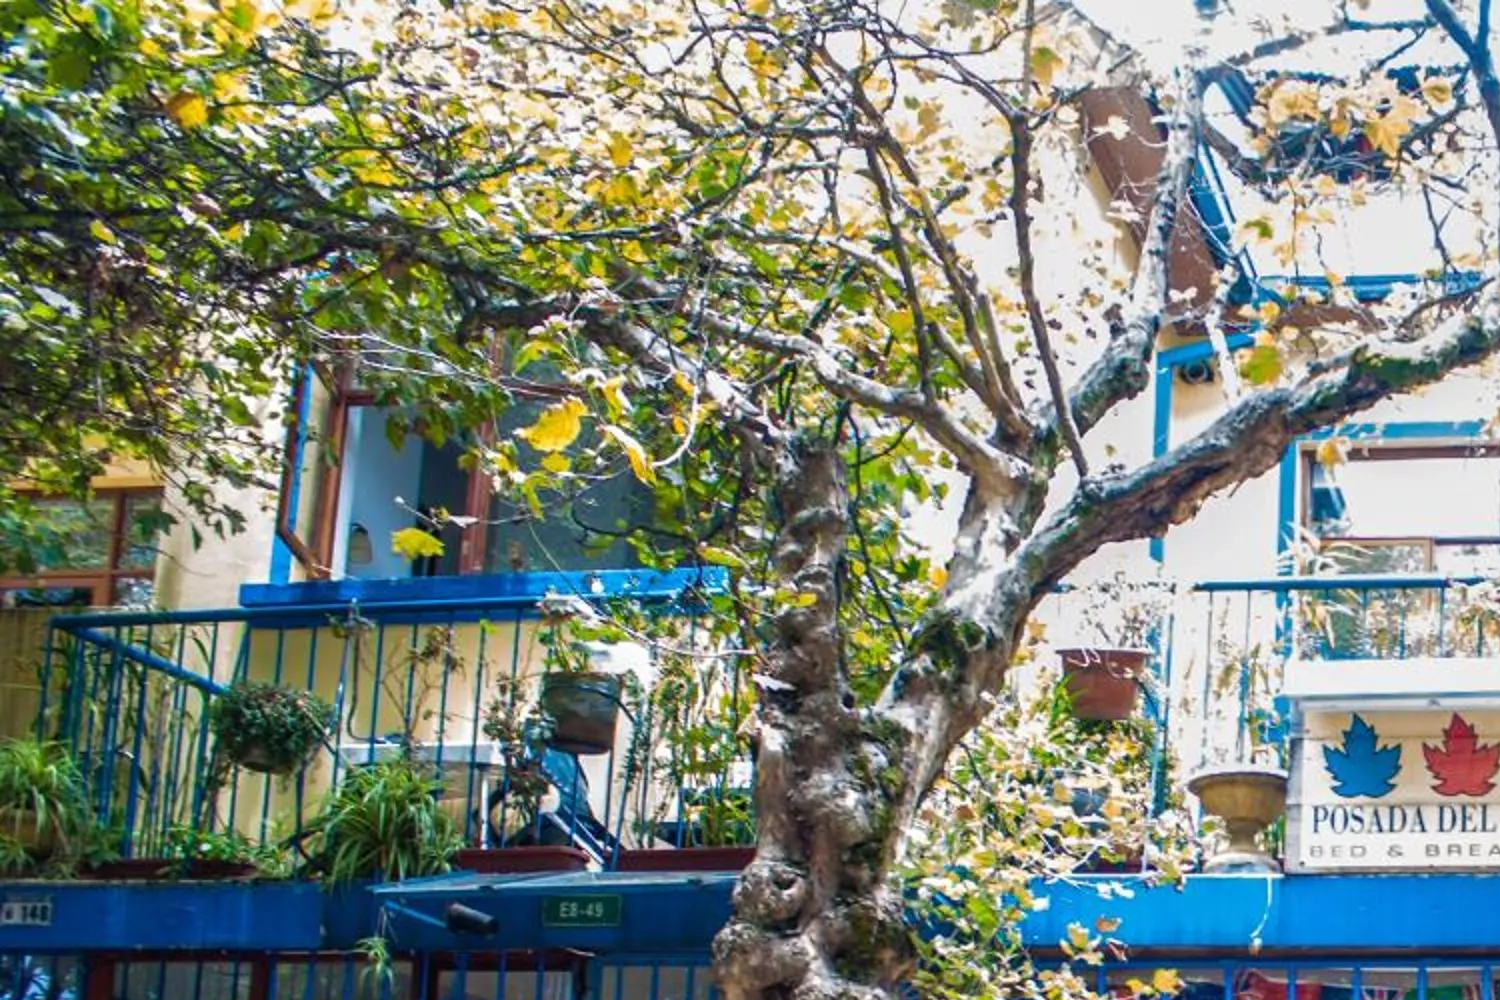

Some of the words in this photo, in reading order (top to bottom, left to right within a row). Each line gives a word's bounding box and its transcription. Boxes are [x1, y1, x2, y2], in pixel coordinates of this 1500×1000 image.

[1312, 803, 1427, 834] POSADA
[1438, 803, 1496, 833] DEL
[1310, 845, 1367, 858] BED
[1387, 844, 1404, 858] &
